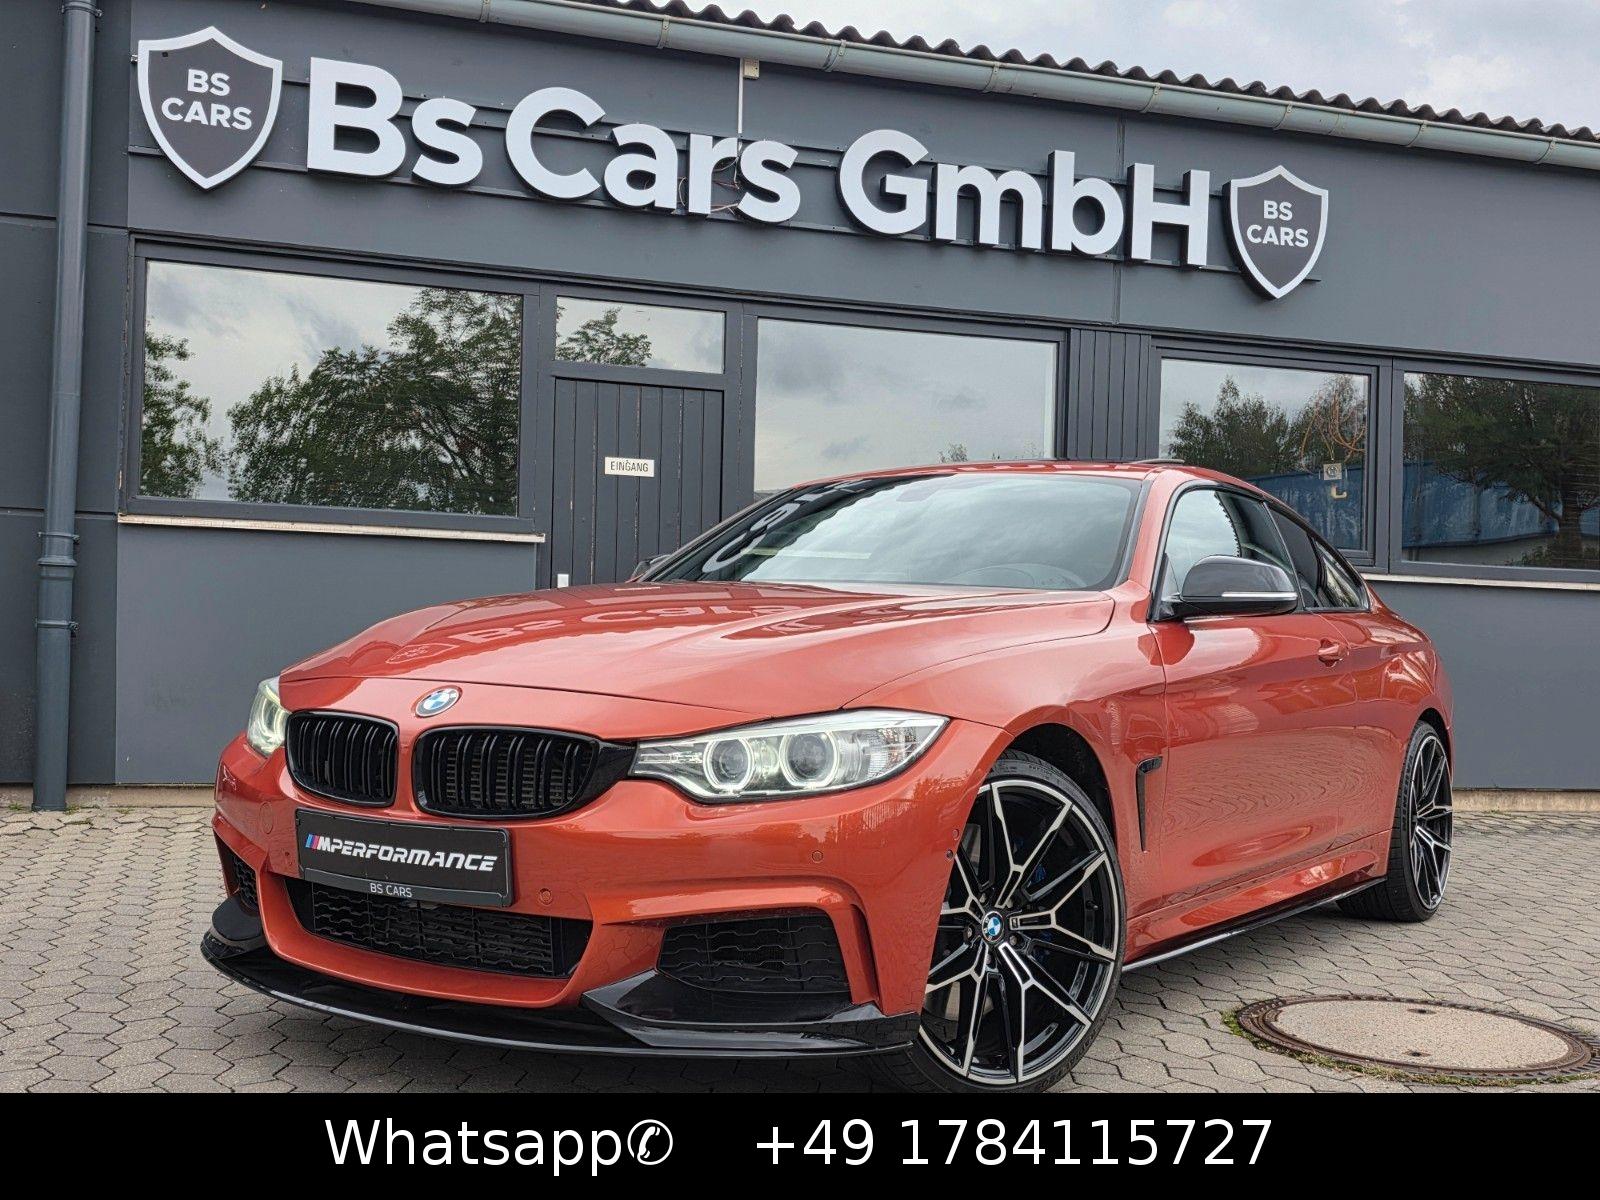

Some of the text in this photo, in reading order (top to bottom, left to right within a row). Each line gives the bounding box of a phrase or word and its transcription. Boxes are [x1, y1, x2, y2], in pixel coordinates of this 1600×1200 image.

[187, 68, 231, 96] BS
[161, 97, 253, 131] CARS
[306, 57, 1210, 266] Bs Cars GmbH
[1263, 199, 1293, 221] BS
[1246, 224, 1309, 248] CARS
[610, 461, 649, 473] EINGANG
[369, 882, 413, 898] BS CARS
